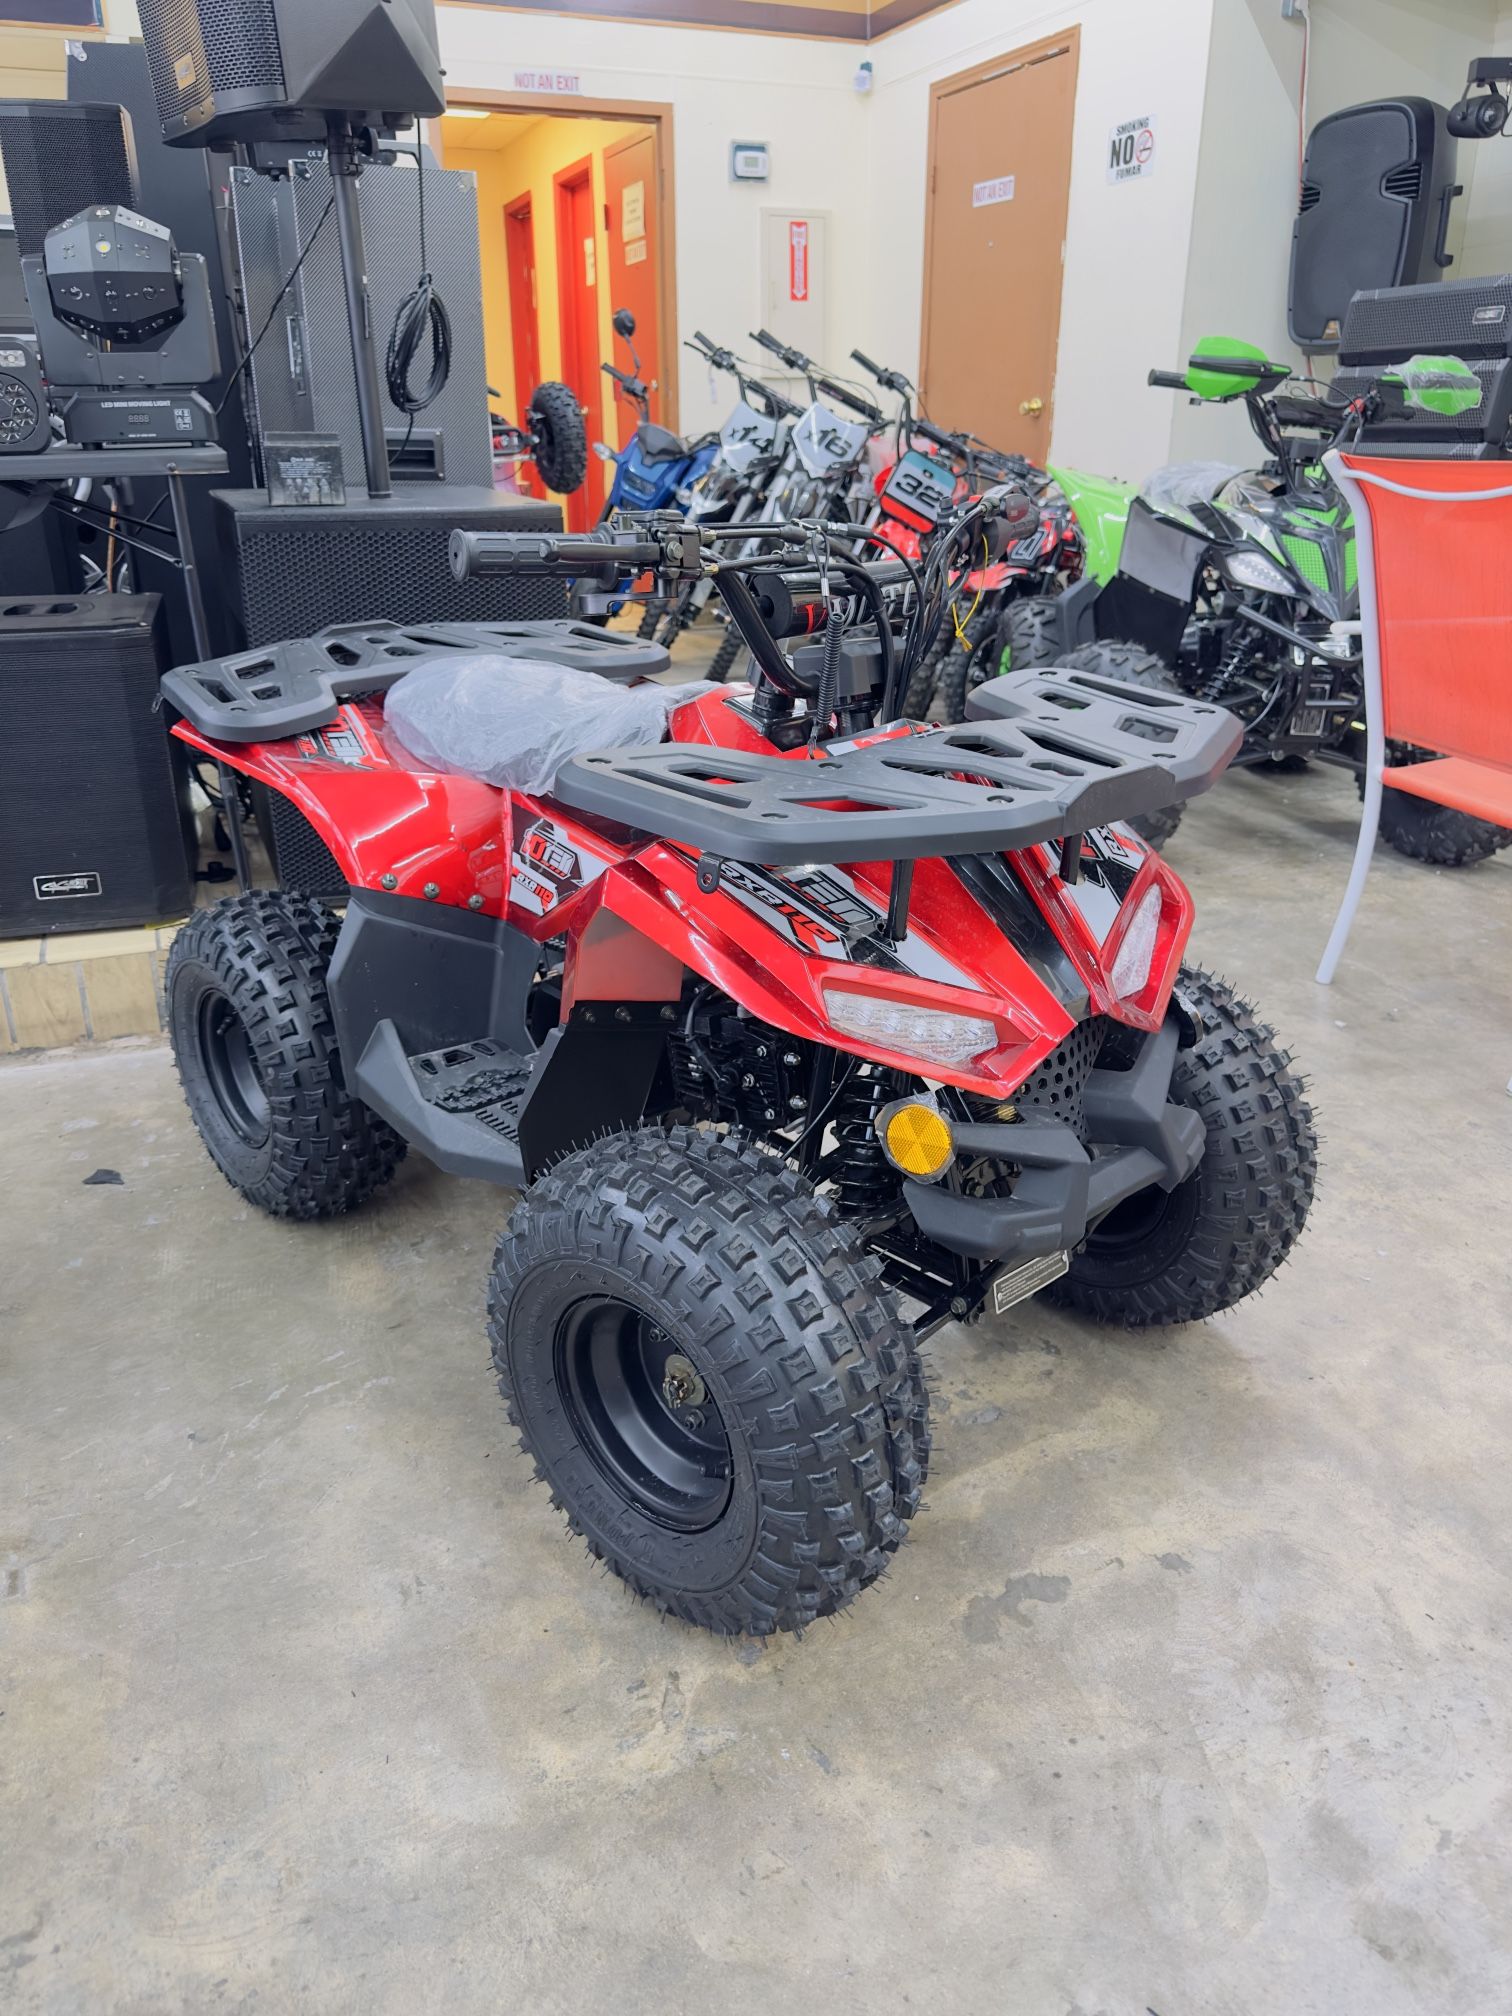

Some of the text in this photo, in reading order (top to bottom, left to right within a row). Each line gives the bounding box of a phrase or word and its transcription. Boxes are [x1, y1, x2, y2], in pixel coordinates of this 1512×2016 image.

[514, 73, 580, 91] NOT AN EXIT
[1116, 116, 1149, 136] SMOKING
[1110, 134, 1135, 169] NO
[1115, 164, 1142, 180] FUMAR
[974, 180, 1013, 203] NOT AN EXIT
